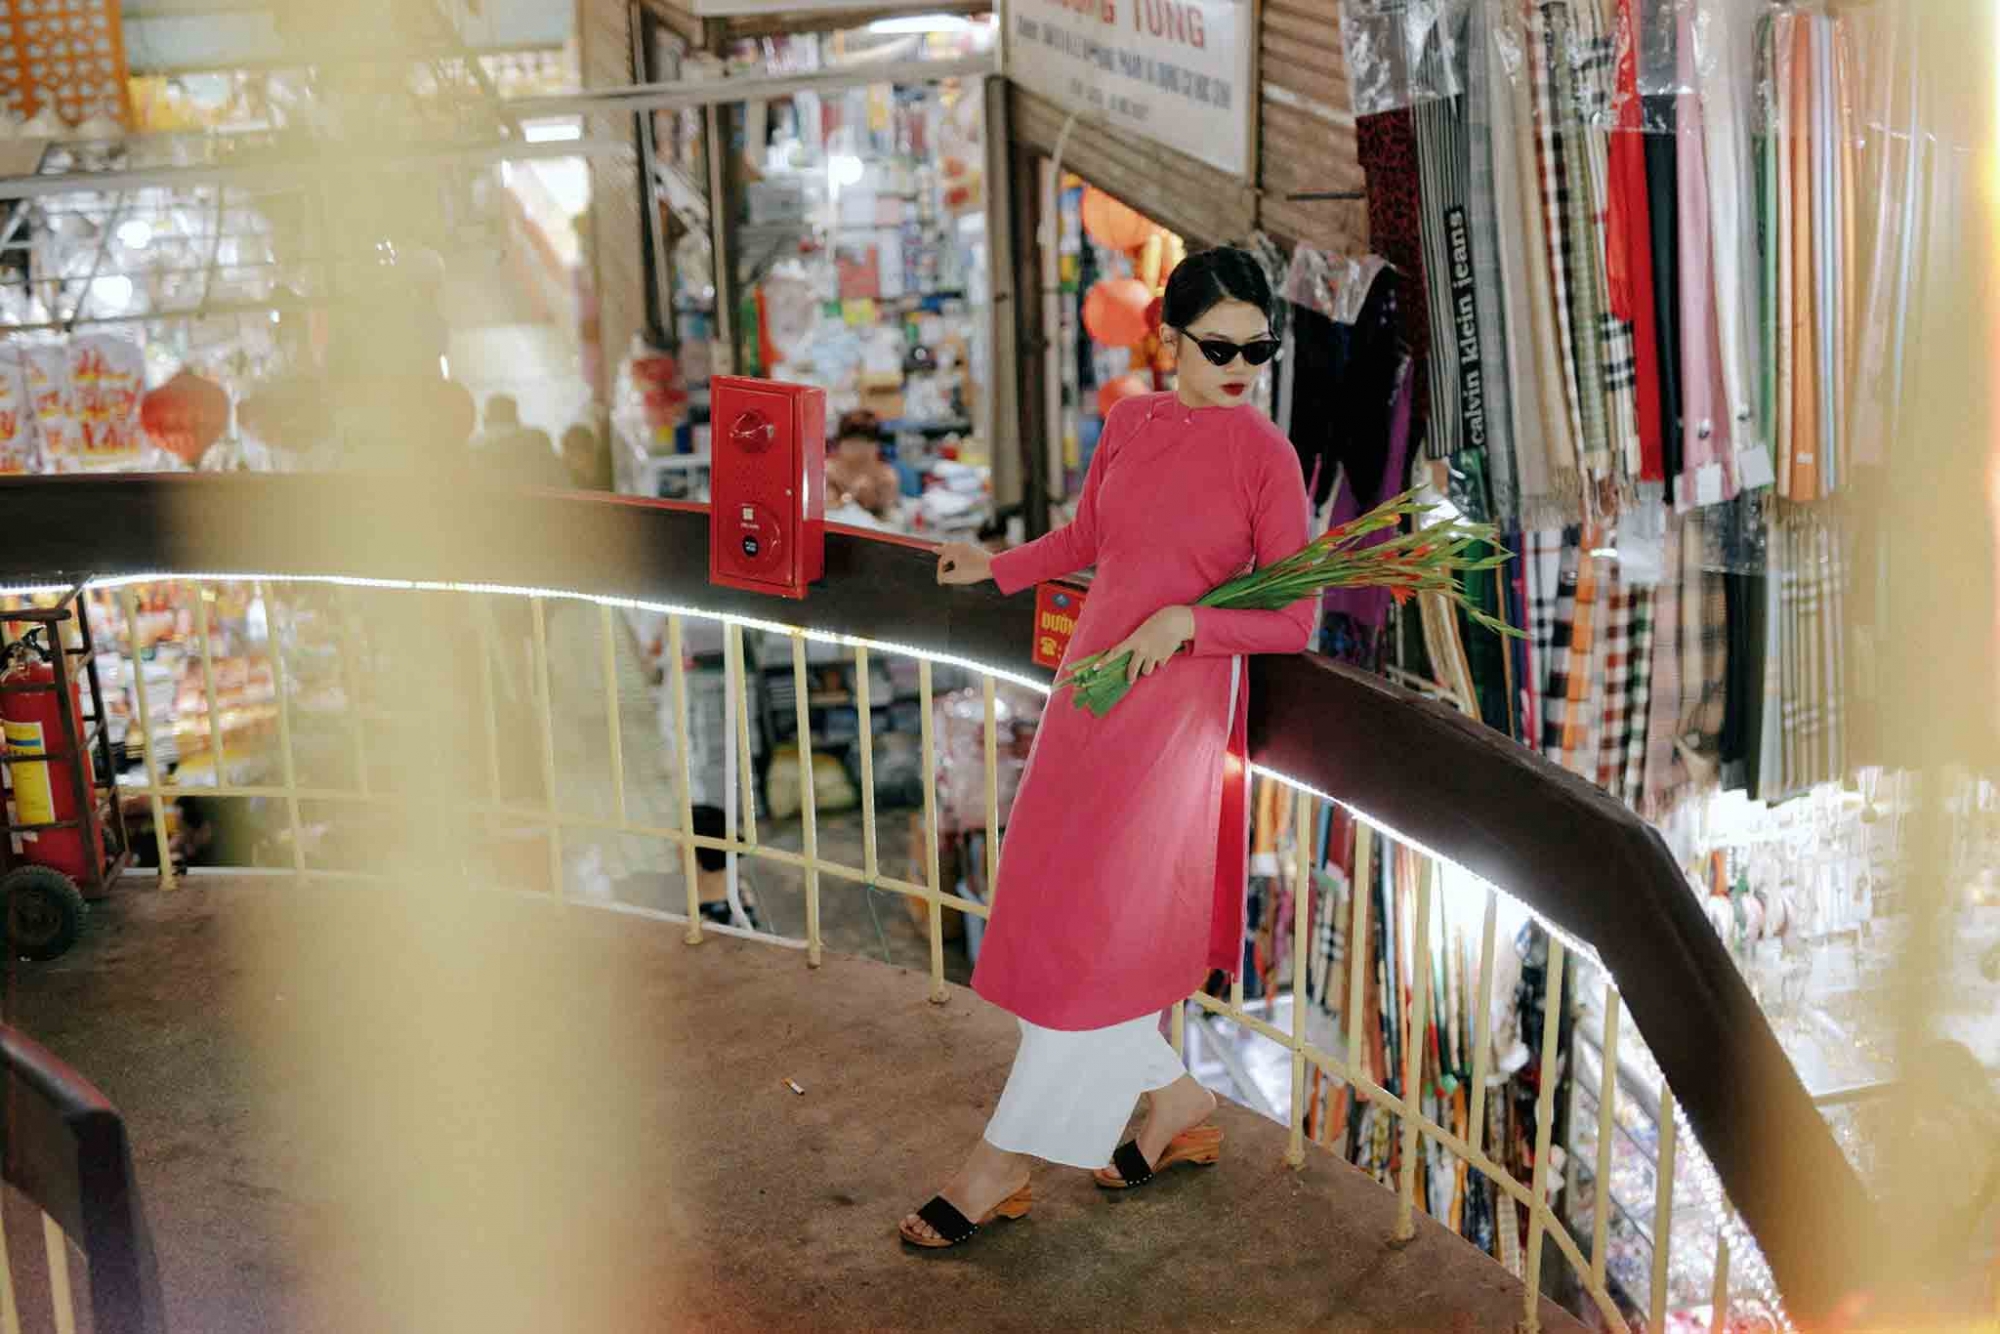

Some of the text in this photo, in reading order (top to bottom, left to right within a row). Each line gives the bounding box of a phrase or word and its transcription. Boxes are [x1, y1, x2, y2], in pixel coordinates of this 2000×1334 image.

[1448, 211, 1485, 445] calvin klein jeans
